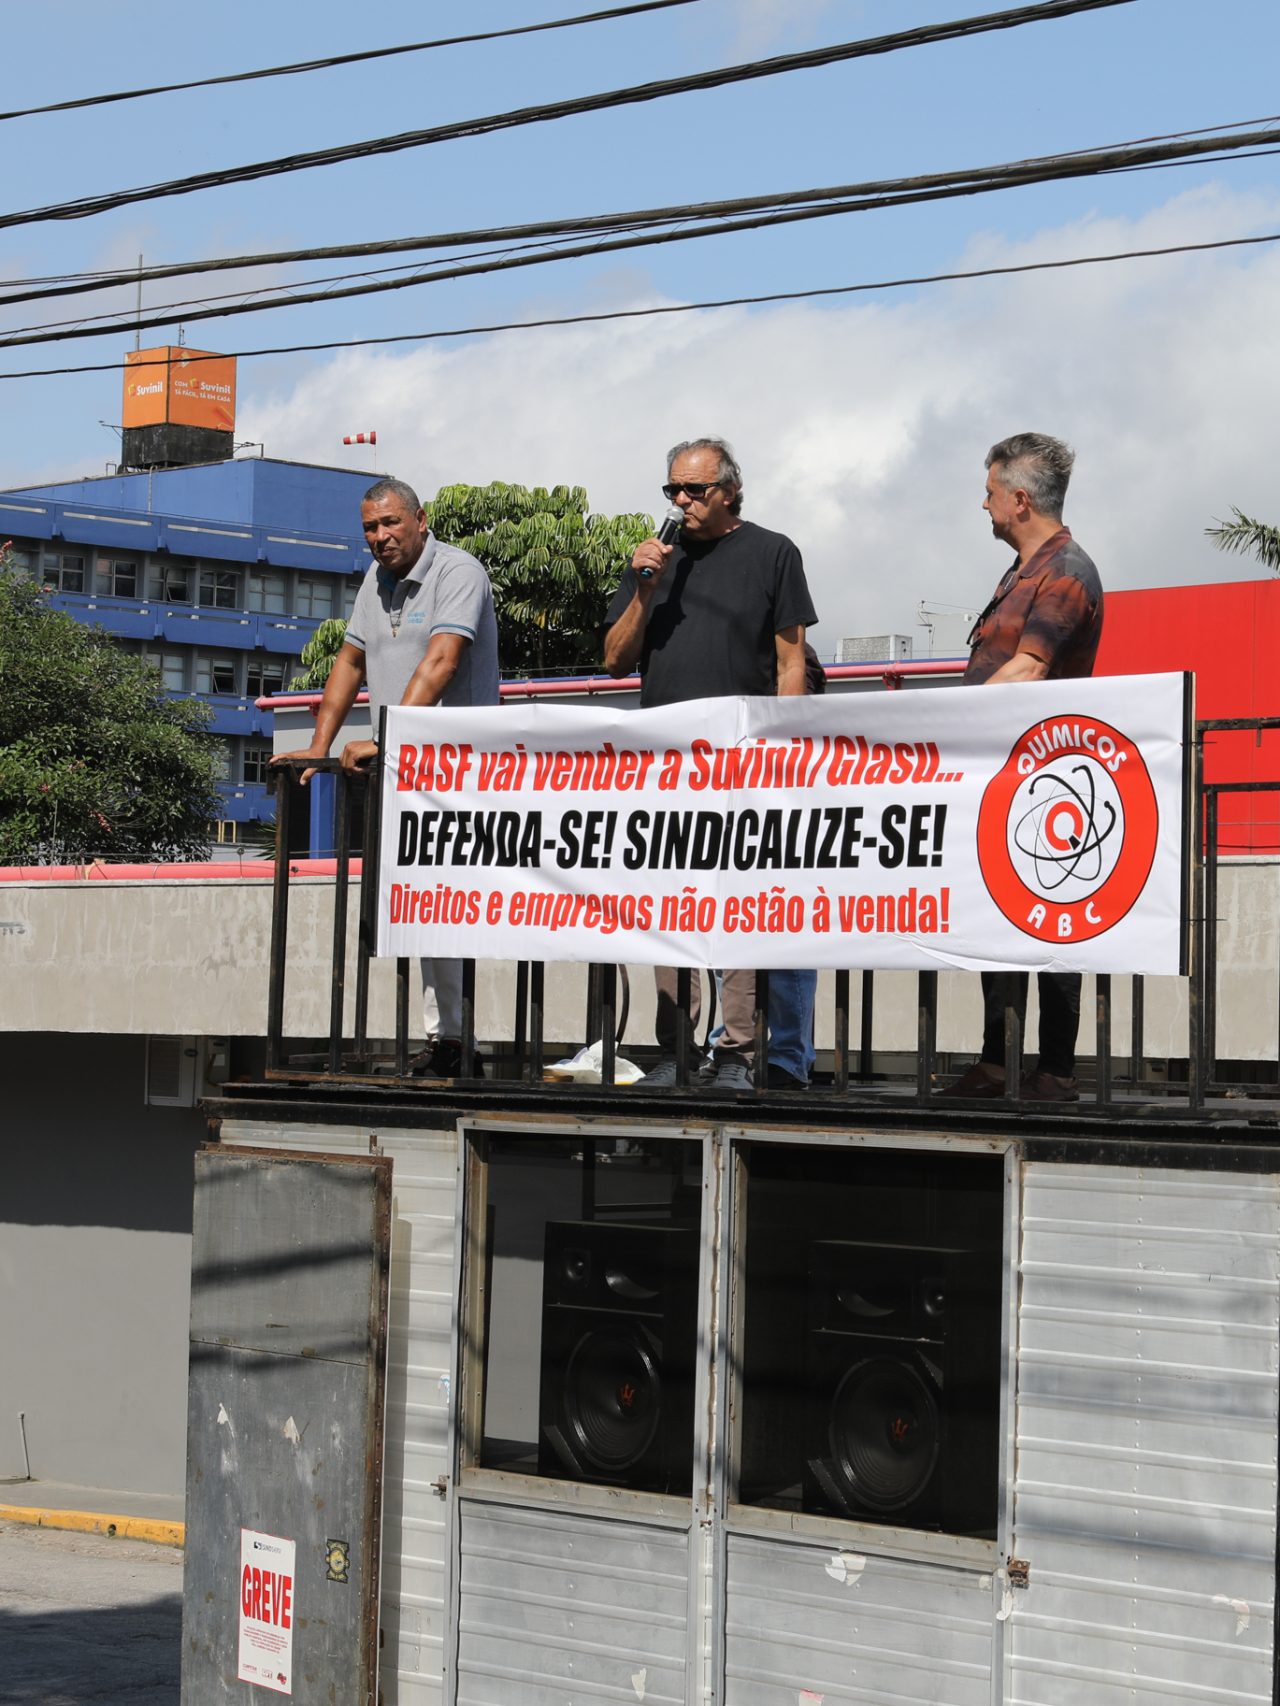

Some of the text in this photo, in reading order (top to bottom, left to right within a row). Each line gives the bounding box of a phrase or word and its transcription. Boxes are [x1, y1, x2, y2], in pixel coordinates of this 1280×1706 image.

[136, 381, 164, 396] Suvinil
[200, 382, 232, 395] Suvinil
[397, 744, 473, 792] BASF
[478, 743, 525, 792] vai
[534, 743, 655, 792] vender
[662, 749, 683, 791] a
[1017, 723, 1127, 775] QUÍMICOS
[397, 804, 947, 871] DEFENDA-SE! SINDICALIZE-SE!
[390, 883, 950, 935] Direitos e empregos não estão à venda!
[241, 1564, 292, 1629] GREVE
